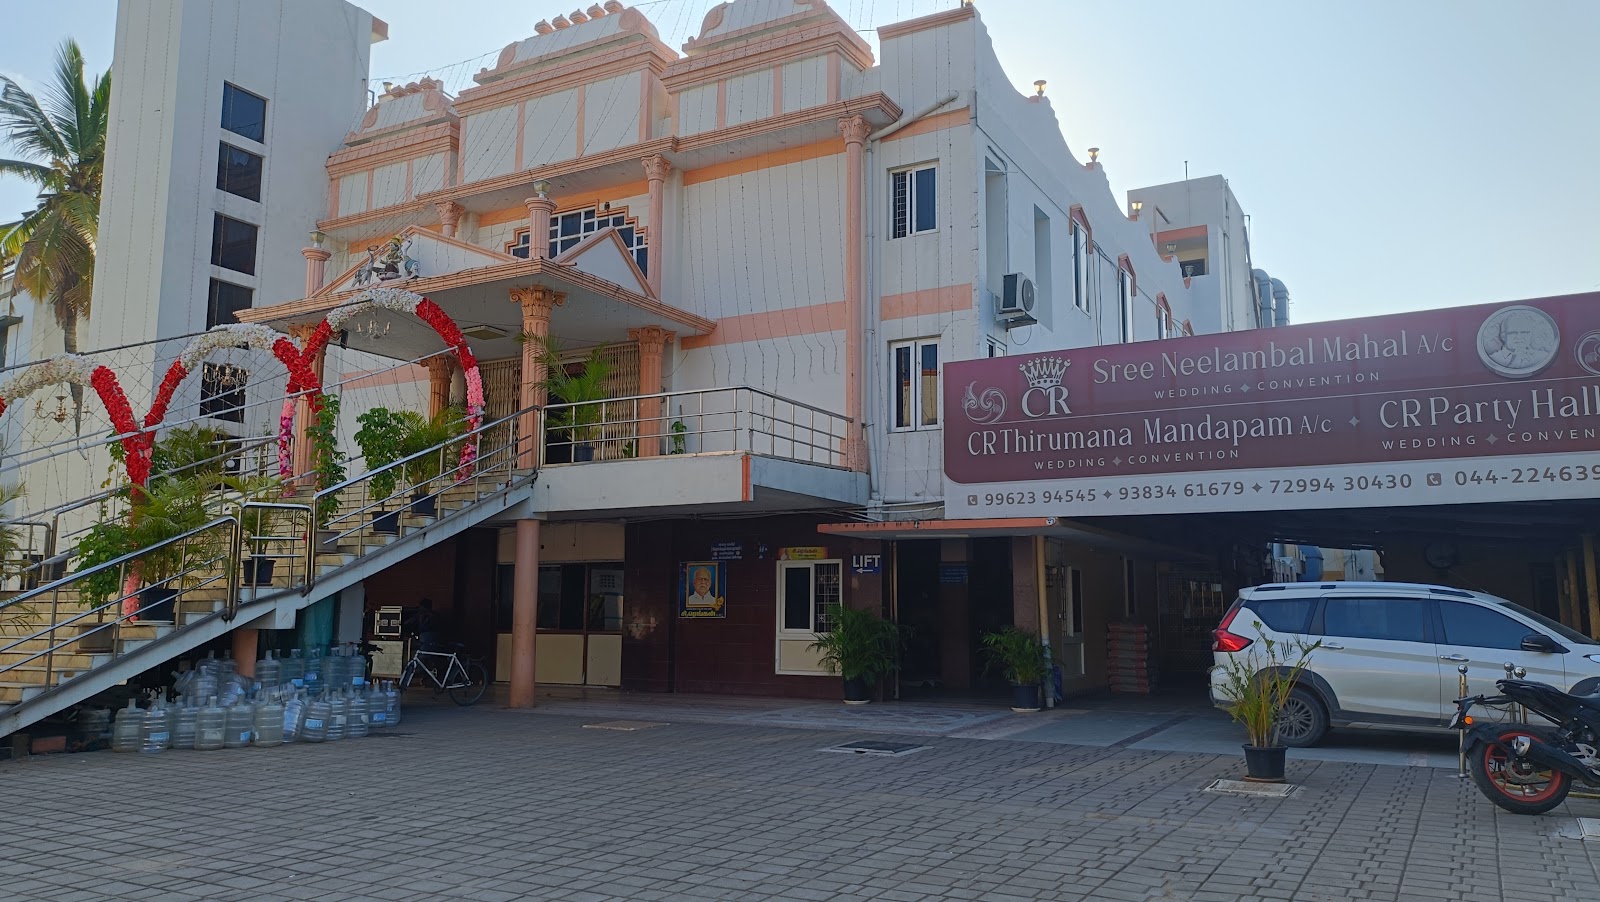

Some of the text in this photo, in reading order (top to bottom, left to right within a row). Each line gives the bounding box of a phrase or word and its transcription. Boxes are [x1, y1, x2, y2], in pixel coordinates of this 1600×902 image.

[1093, 330, 1453, 385] Sree Neelambal Mahal A/c
[1154, 371, 1380, 399] WEDDING CONVENTION
[1021, 385, 1072, 418] CR
[1531, 385, 1600, 419] Hall
[1143, 414, 1293, 446] Mandapam
[1299, 415, 1332, 435] A/c
[1381, 428, 1595, 450] WEDDING CONVEN
[1034, 449, 1239, 470] WEDDING CONVENTION
[985, 474, 1412, 506] 99623 94545 93834 61679 72994 30430
[852, 555, 881, 568] LIFT
